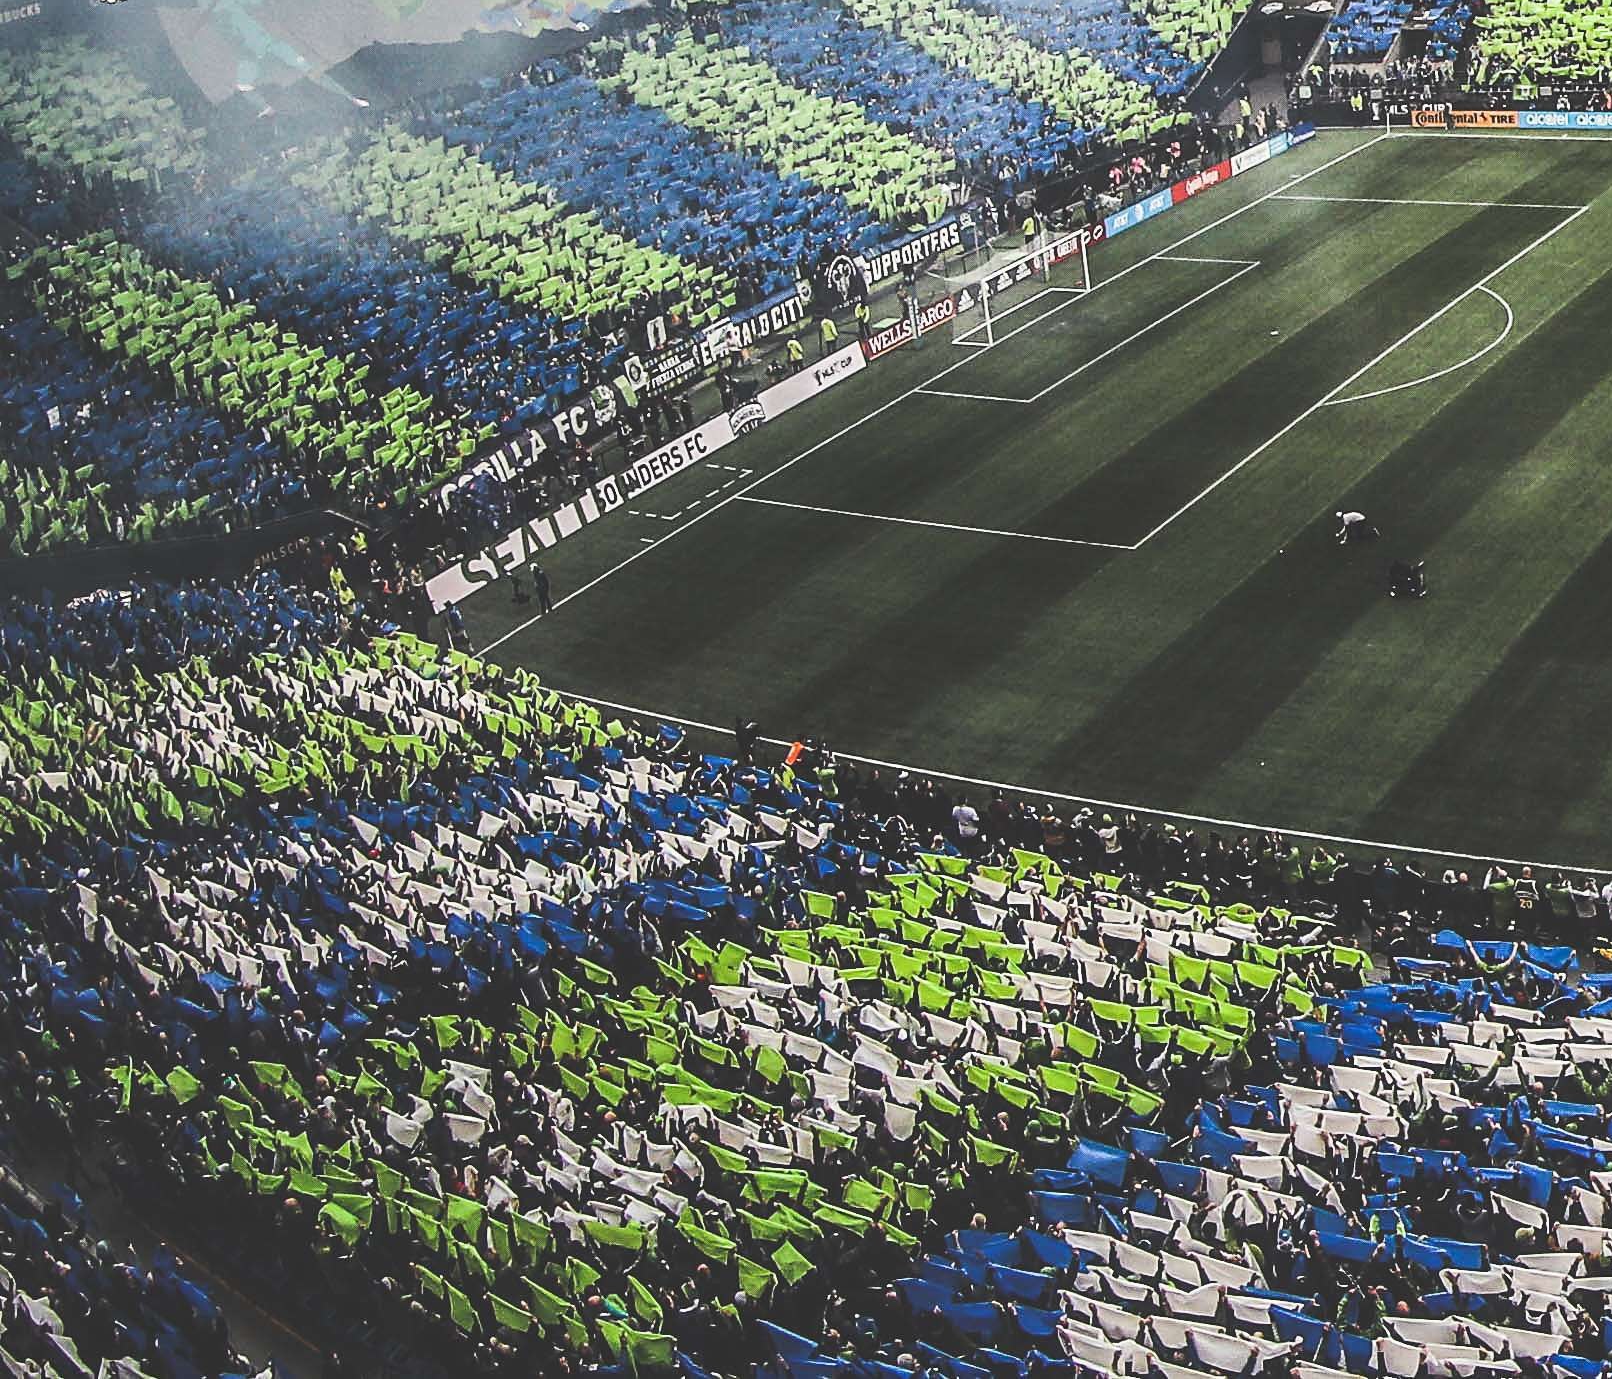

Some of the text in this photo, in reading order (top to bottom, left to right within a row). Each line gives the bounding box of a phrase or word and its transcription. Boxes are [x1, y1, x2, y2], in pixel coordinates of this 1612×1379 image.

[1421, 102, 1451, 114] CUP
[1489, 114, 1516, 125] TIRE
[1526, 112, 1569, 127] alcatel
[862, 222, 960, 287] SUPPORTERS
[770, 295, 805, 332] CITY
[868, 321, 912, 355] WELLS
[553, 406, 589, 444] FC
[684, 432, 708, 466] FC
